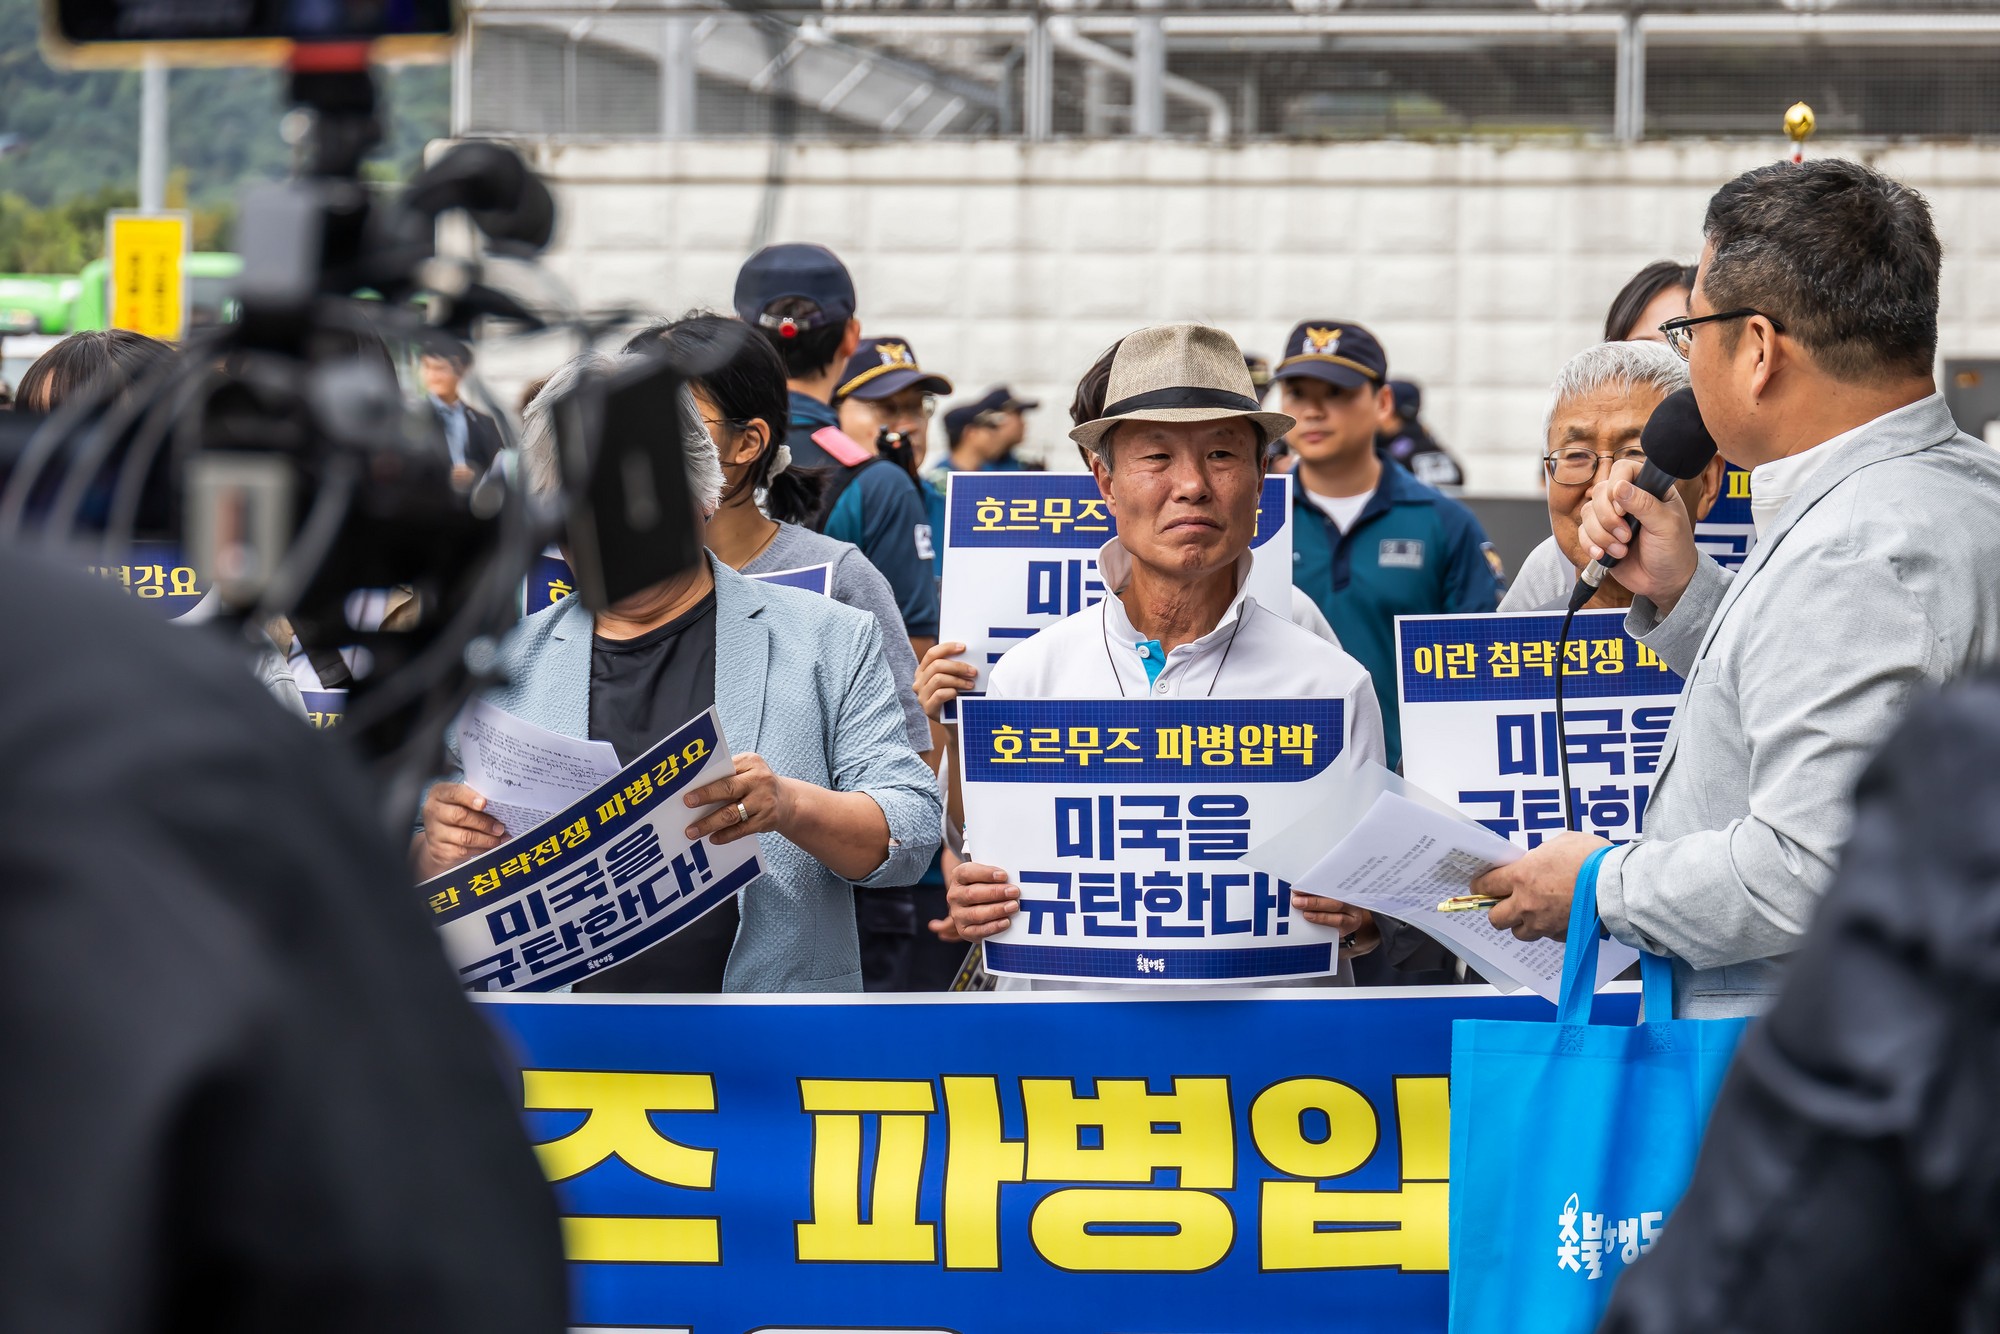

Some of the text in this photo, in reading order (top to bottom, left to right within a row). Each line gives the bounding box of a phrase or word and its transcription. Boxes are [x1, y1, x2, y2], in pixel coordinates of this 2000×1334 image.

[972, 496, 1109, 533] 호르무즈
[1414, 643, 1478, 679] 이란
[1487, 638, 1625, 678] 침략전쟁
[990, 723, 1318, 766] 호르무즈 파병압박
[1496, 706, 1677, 777] 미국을
[467, 815, 592, 897] 침략전쟁
[595, 738, 711, 826] 파병강요
[1054, 794, 1251, 862] 미국을
[459, 839, 714, 992] 규탄한다!
[484, 823, 665, 947] 미국을
[1019, 870, 1291, 938] 규탄한다!
[793, 1073, 1450, 1274] 파병압
